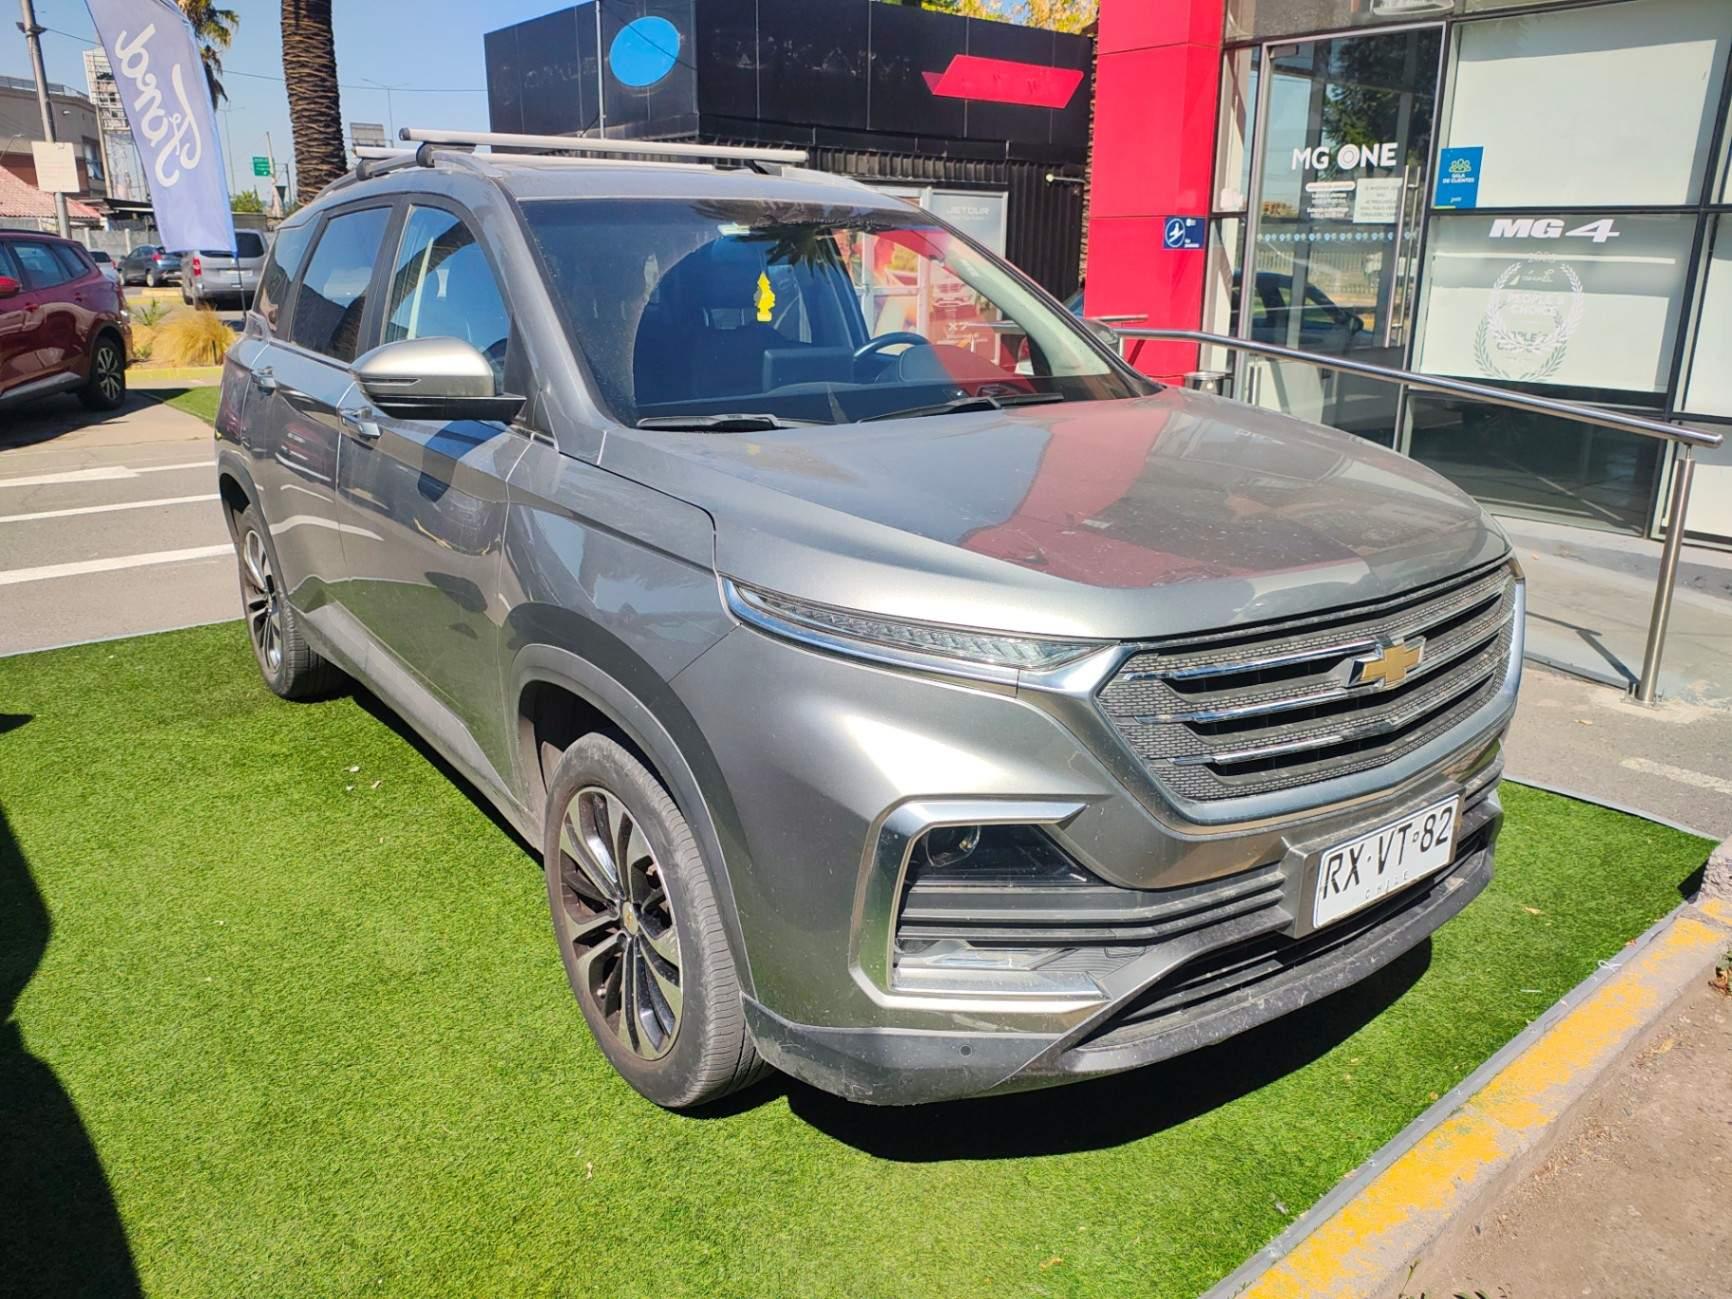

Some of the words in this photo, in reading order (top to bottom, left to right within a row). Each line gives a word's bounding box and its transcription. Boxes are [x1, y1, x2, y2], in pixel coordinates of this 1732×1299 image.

[1291, 146, 1330, 171] MG
[1337, 142, 1399, 170] ONE
[1489, 218, 1565, 238] MG
[1565, 218, 1621, 243] 4
